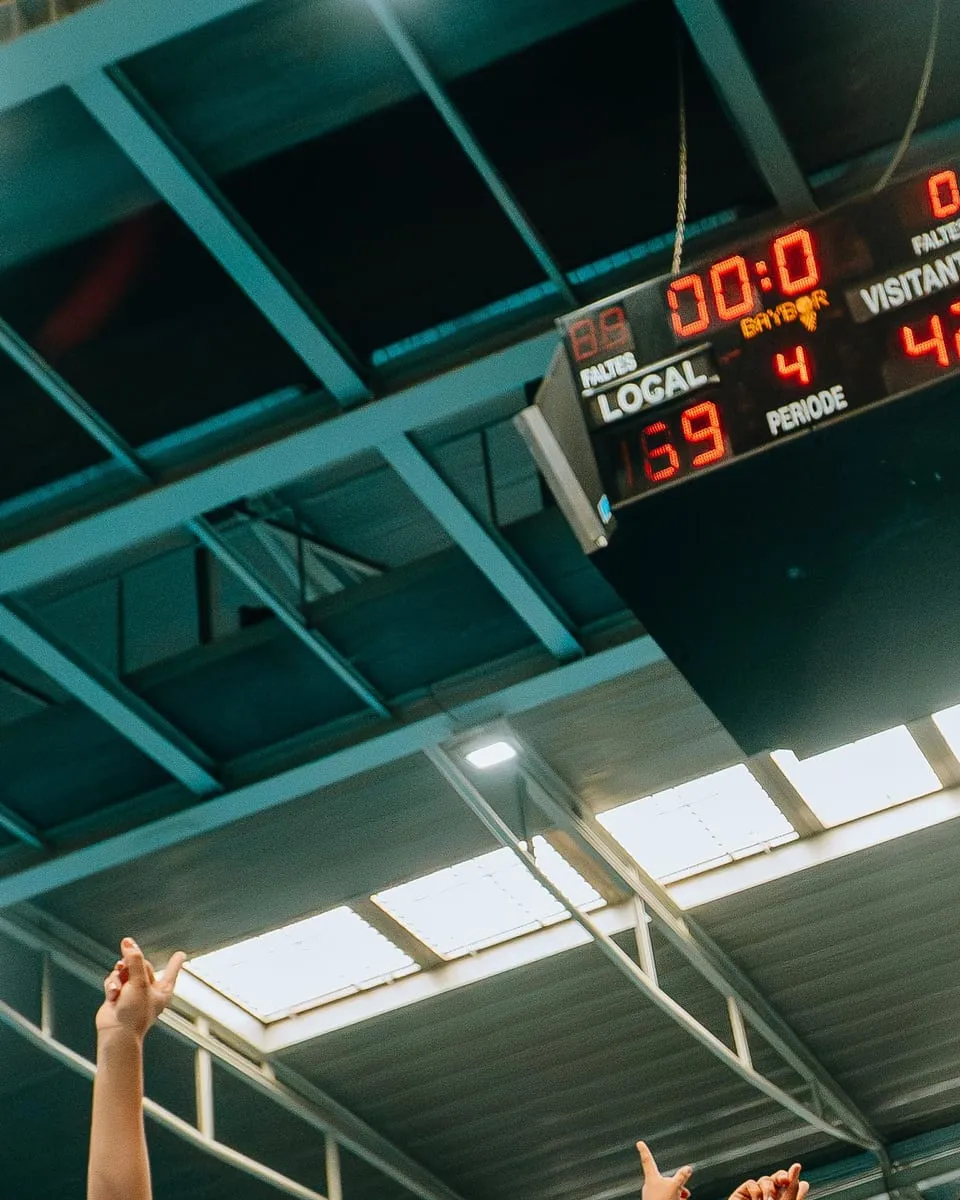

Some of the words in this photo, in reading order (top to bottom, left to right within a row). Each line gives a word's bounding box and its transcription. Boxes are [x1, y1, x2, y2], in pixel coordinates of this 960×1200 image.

[580, 352, 638, 388] FALTES
[775, 345, 811, 386] 4
[597, 360, 708, 424] LOCAL
[765, 385, 849, 436] PERIODE
